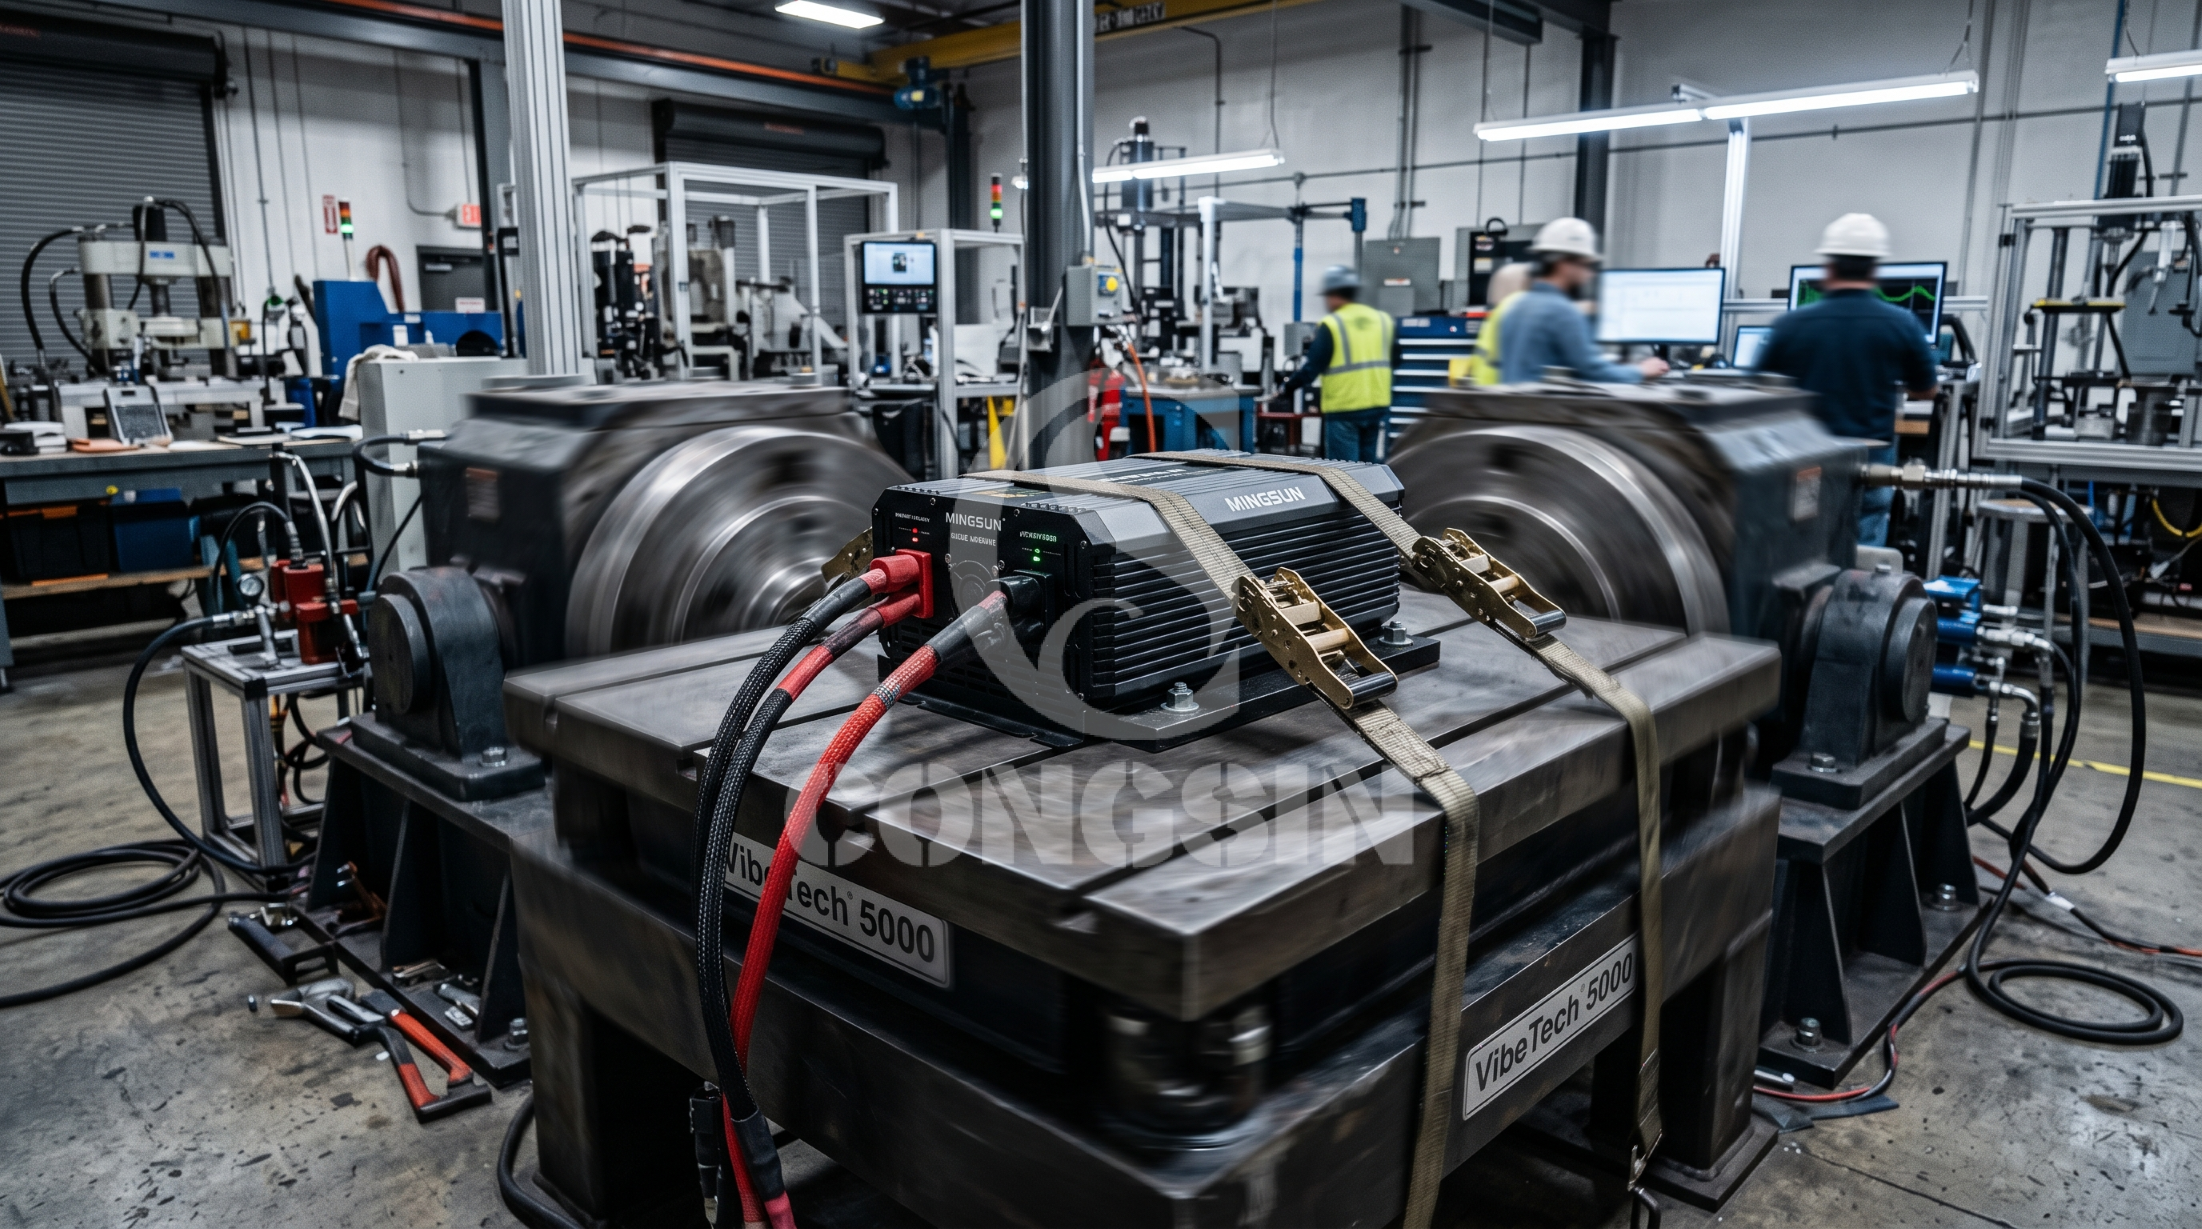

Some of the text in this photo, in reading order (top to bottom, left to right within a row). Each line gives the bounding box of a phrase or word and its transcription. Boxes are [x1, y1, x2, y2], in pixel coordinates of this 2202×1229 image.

[1225, 486, 1306, 512] MINGSUN
[945, 512, 1002, 531] MINGSUN
[860, 899, 934, 963] 5000
[1586, 952, 1633, 1011] 5000
